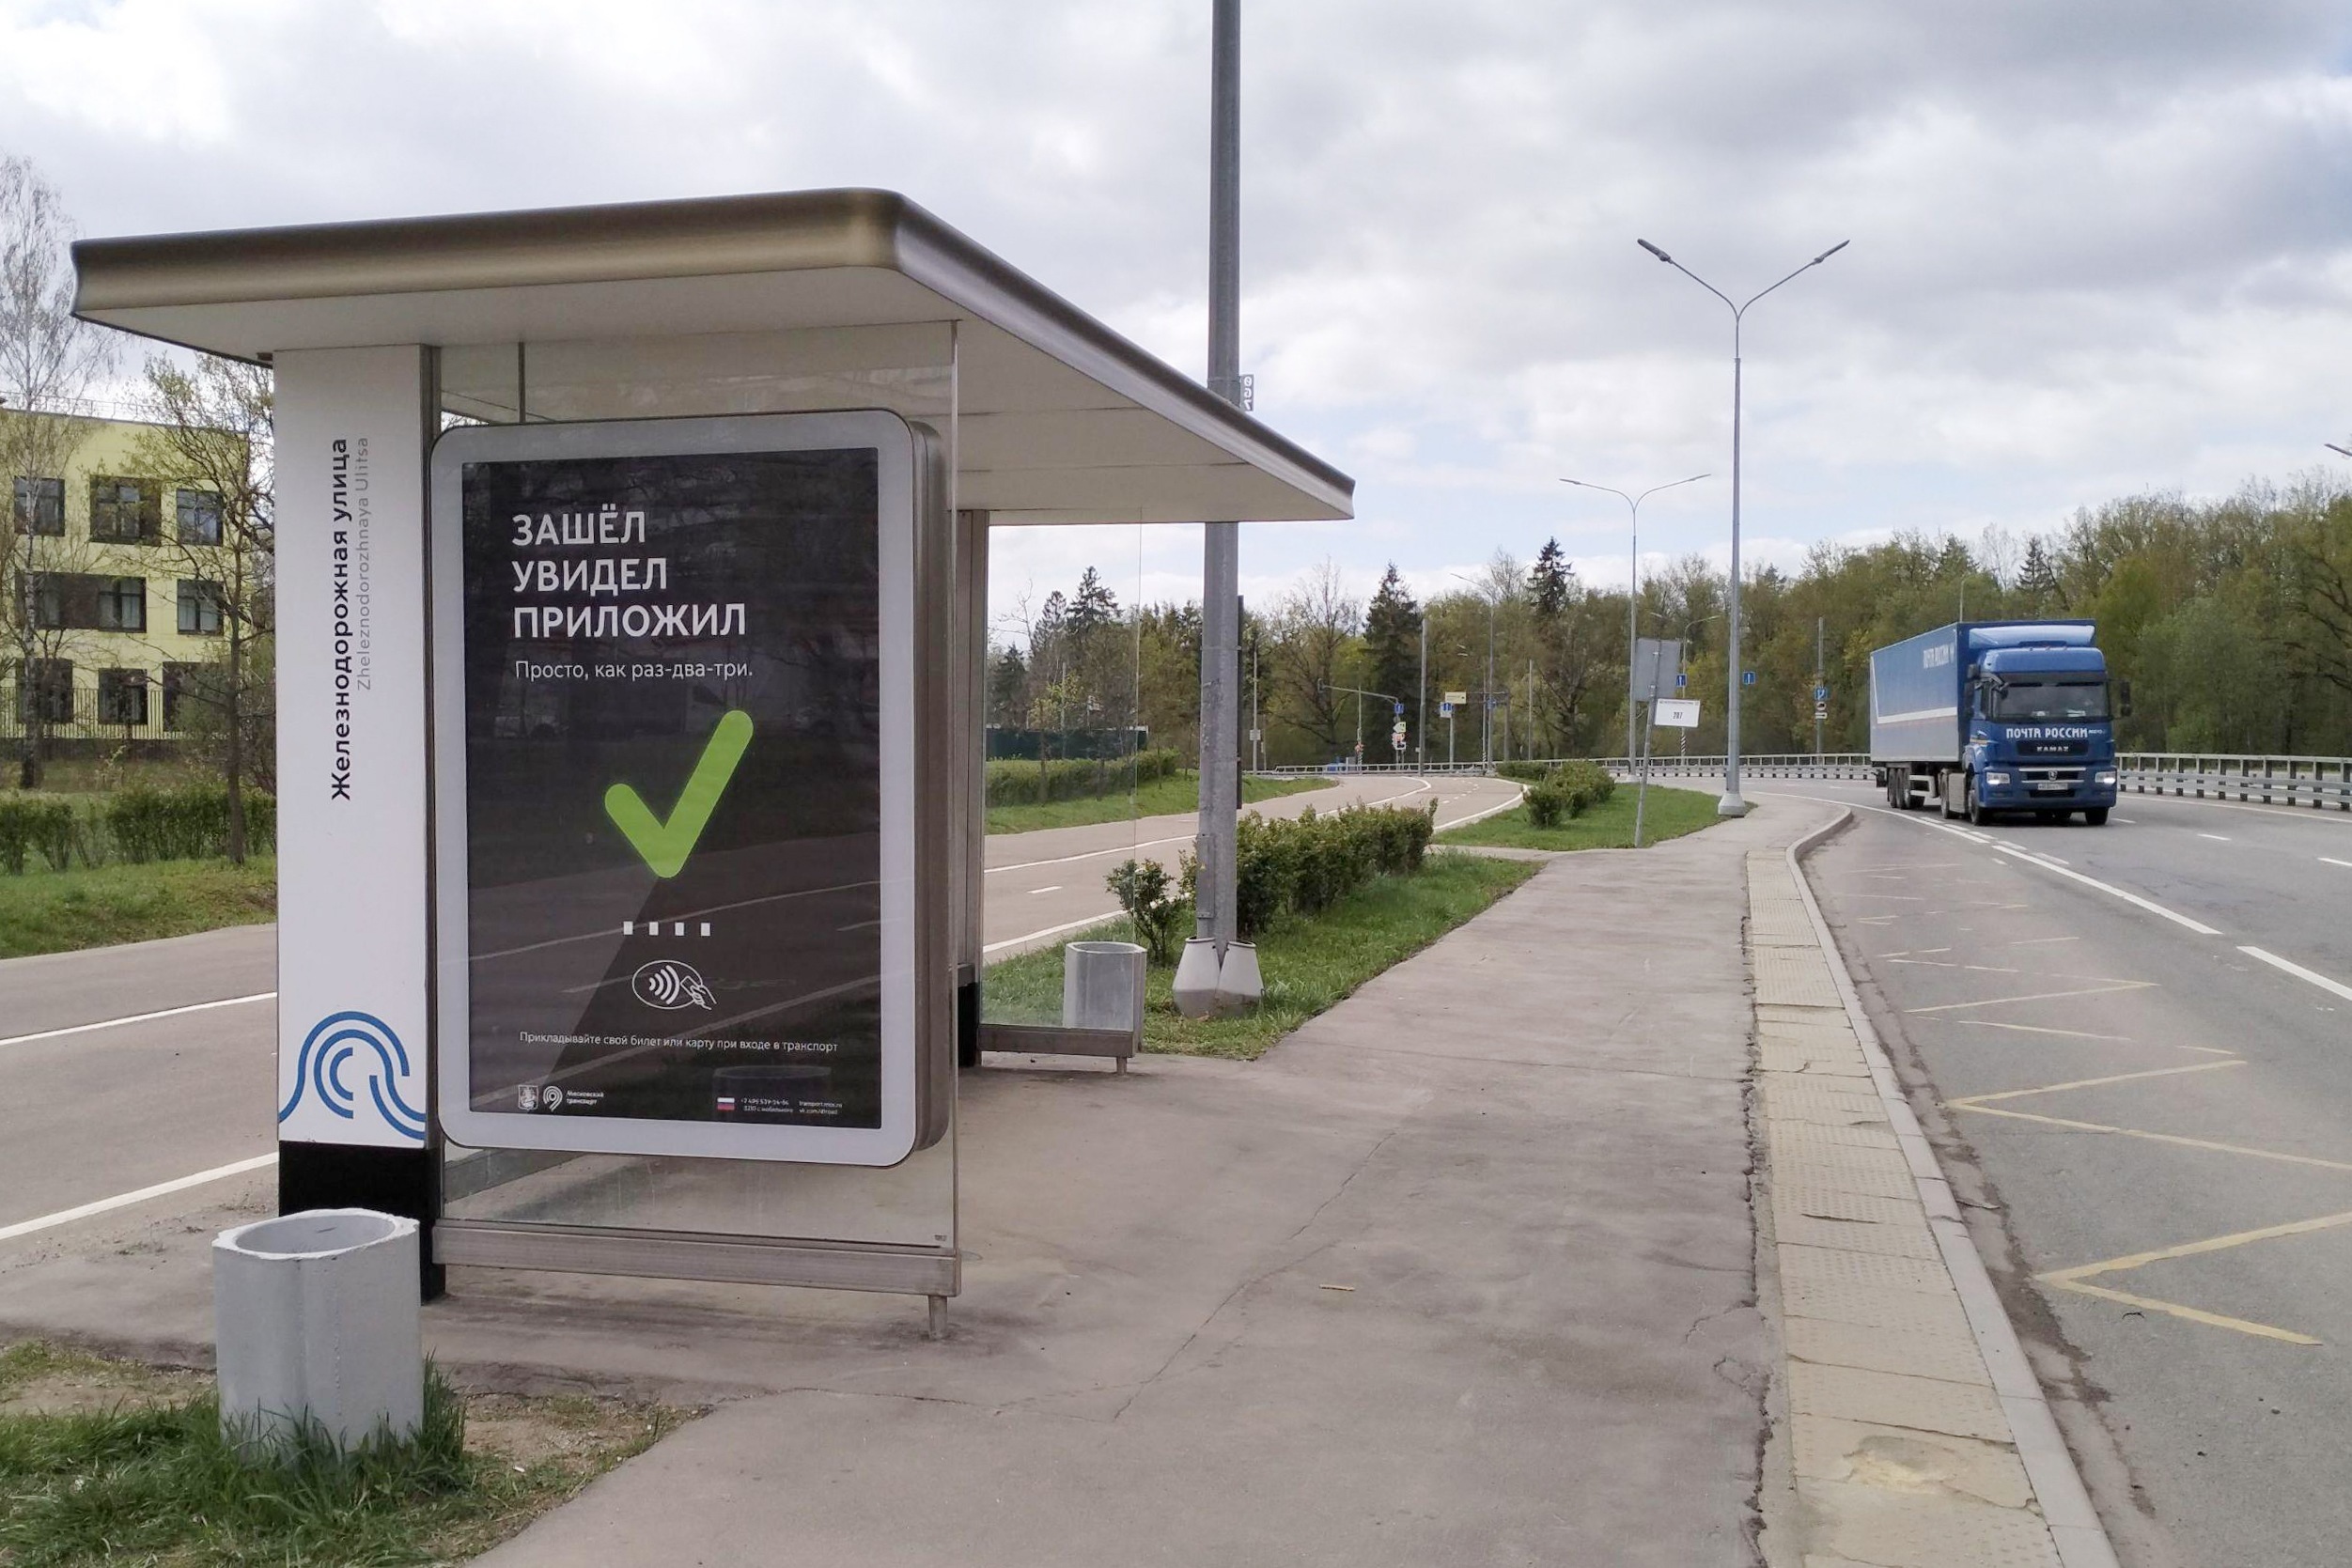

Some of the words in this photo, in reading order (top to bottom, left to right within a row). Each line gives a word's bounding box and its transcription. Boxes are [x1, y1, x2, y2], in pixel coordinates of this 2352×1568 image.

[332, 438, 353, 521] улица
[356, 437, 369, 491] Ulitsa
[511, 504, 646, 546] ЗАШЁЛ
[355, 497, 373, 691] Zheleznodorozhnaya
[511, 558, 667, 597] УВИДЕЛ
[513, 603, 746, 638] ПРИЛОЖИЛ
[332, 530, 353, 800] Железнодорожная
[515, 660, 589, 681] Просто,
[594, 662, 626, 678] как
[631, 660, 753, 681] раз-два-три.
[2006, 727, 2041, 739] ПОЧТА
[2045, 727, 2088, 738] РОССИИ
[520, 1032, 601, 1048] Прикладывайте
[603, 1034, 628, 1045] свой
[631, 1034, 662, 1047] билет
[663, 1037, 682, 1048] или
[685, 1037, 714, 1050] карту
[718, 1040, 737, 1051] при
[740, 1041, 771, 1051] входе
[783, 1042, 838, 1054] транспорт
